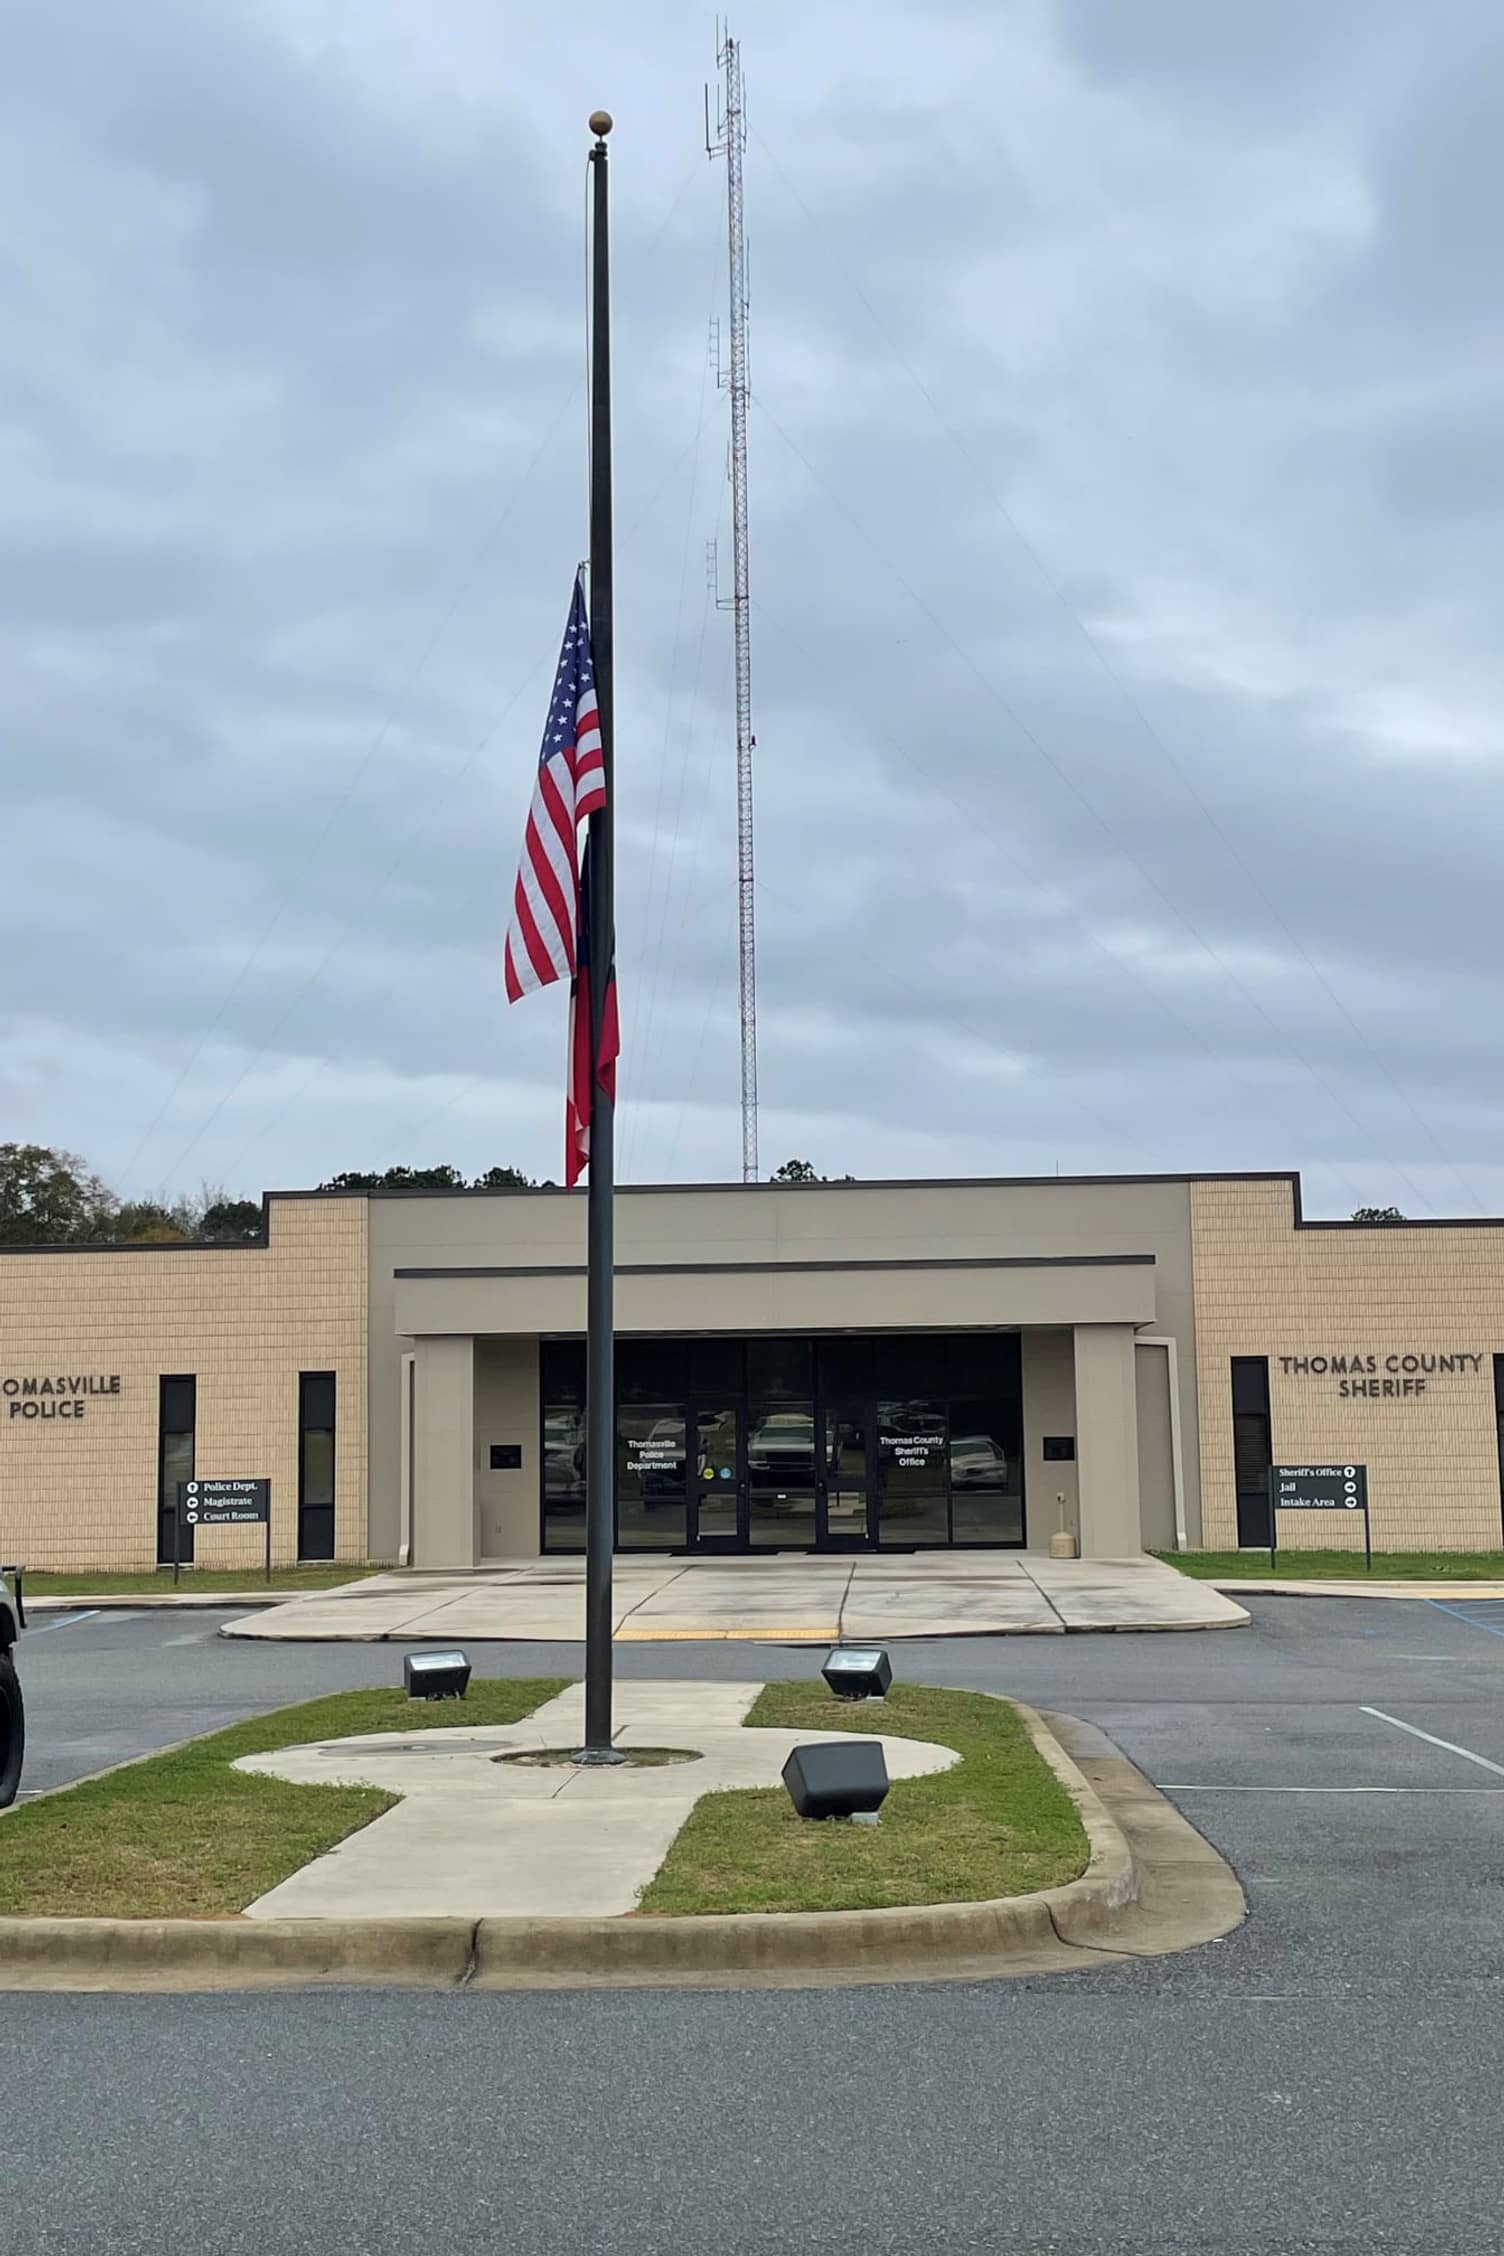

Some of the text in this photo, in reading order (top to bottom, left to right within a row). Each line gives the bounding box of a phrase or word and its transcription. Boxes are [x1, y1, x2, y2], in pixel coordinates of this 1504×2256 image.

[1279, 1353, 1483, 1375] THOMAS COUNTY
[3, 1376, 120, 1396] OMASVILLE
[1339, 1379, 1426, 1398] SHERIFF
[10, 1400, 84, 1419] POLICE
[880, 1436, 943, 1445] Thomas County
[627, 1462, 677, 1470] Department
[899, 1458, 926, 1467] Office
[1279, 1468, 1342, 1477] Sheriff's Office
[204, 1482, 258, 1492] Police Dept.
[1279, 1482, 1296, 1493] Jail
[204, 1497, 252, 1507] Magistrate
[1280, 1497, 1335, 1507] Intake Area
[203, 1511, 259, 1521] Court Room
